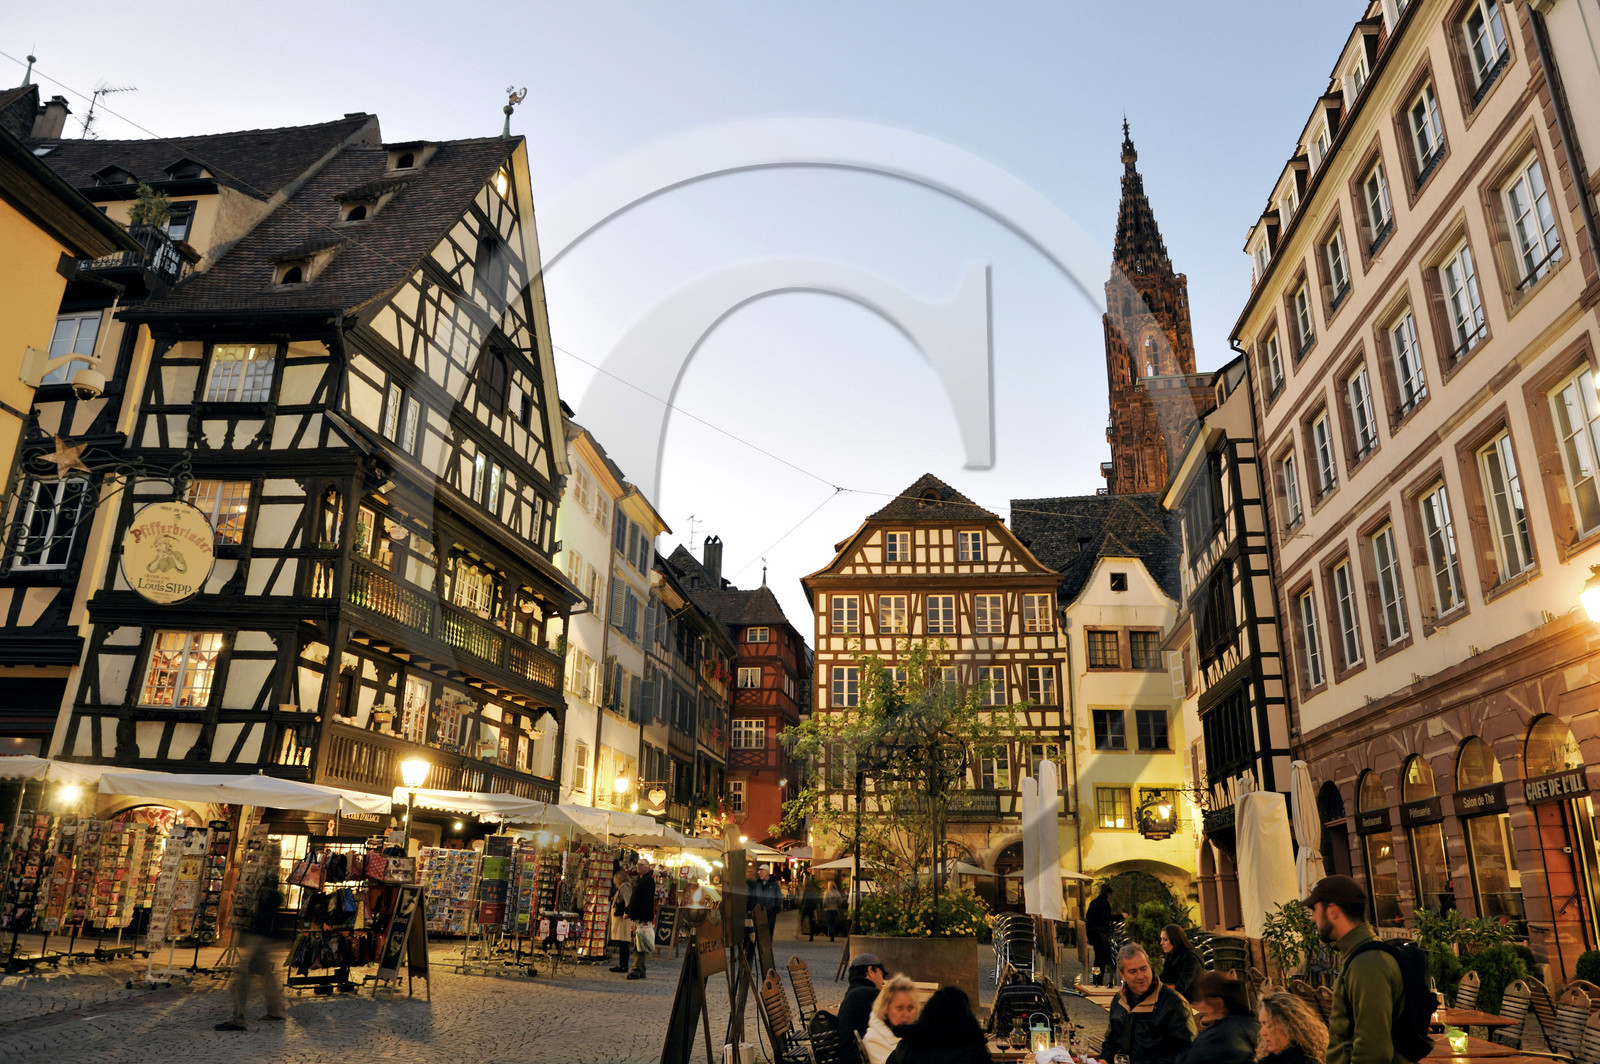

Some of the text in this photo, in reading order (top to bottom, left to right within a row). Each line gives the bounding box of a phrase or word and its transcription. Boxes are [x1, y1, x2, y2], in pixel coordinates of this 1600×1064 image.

[1547, 777, 1562, 797] DE
[1462, 791, 1496, 809] Salon de Thé
